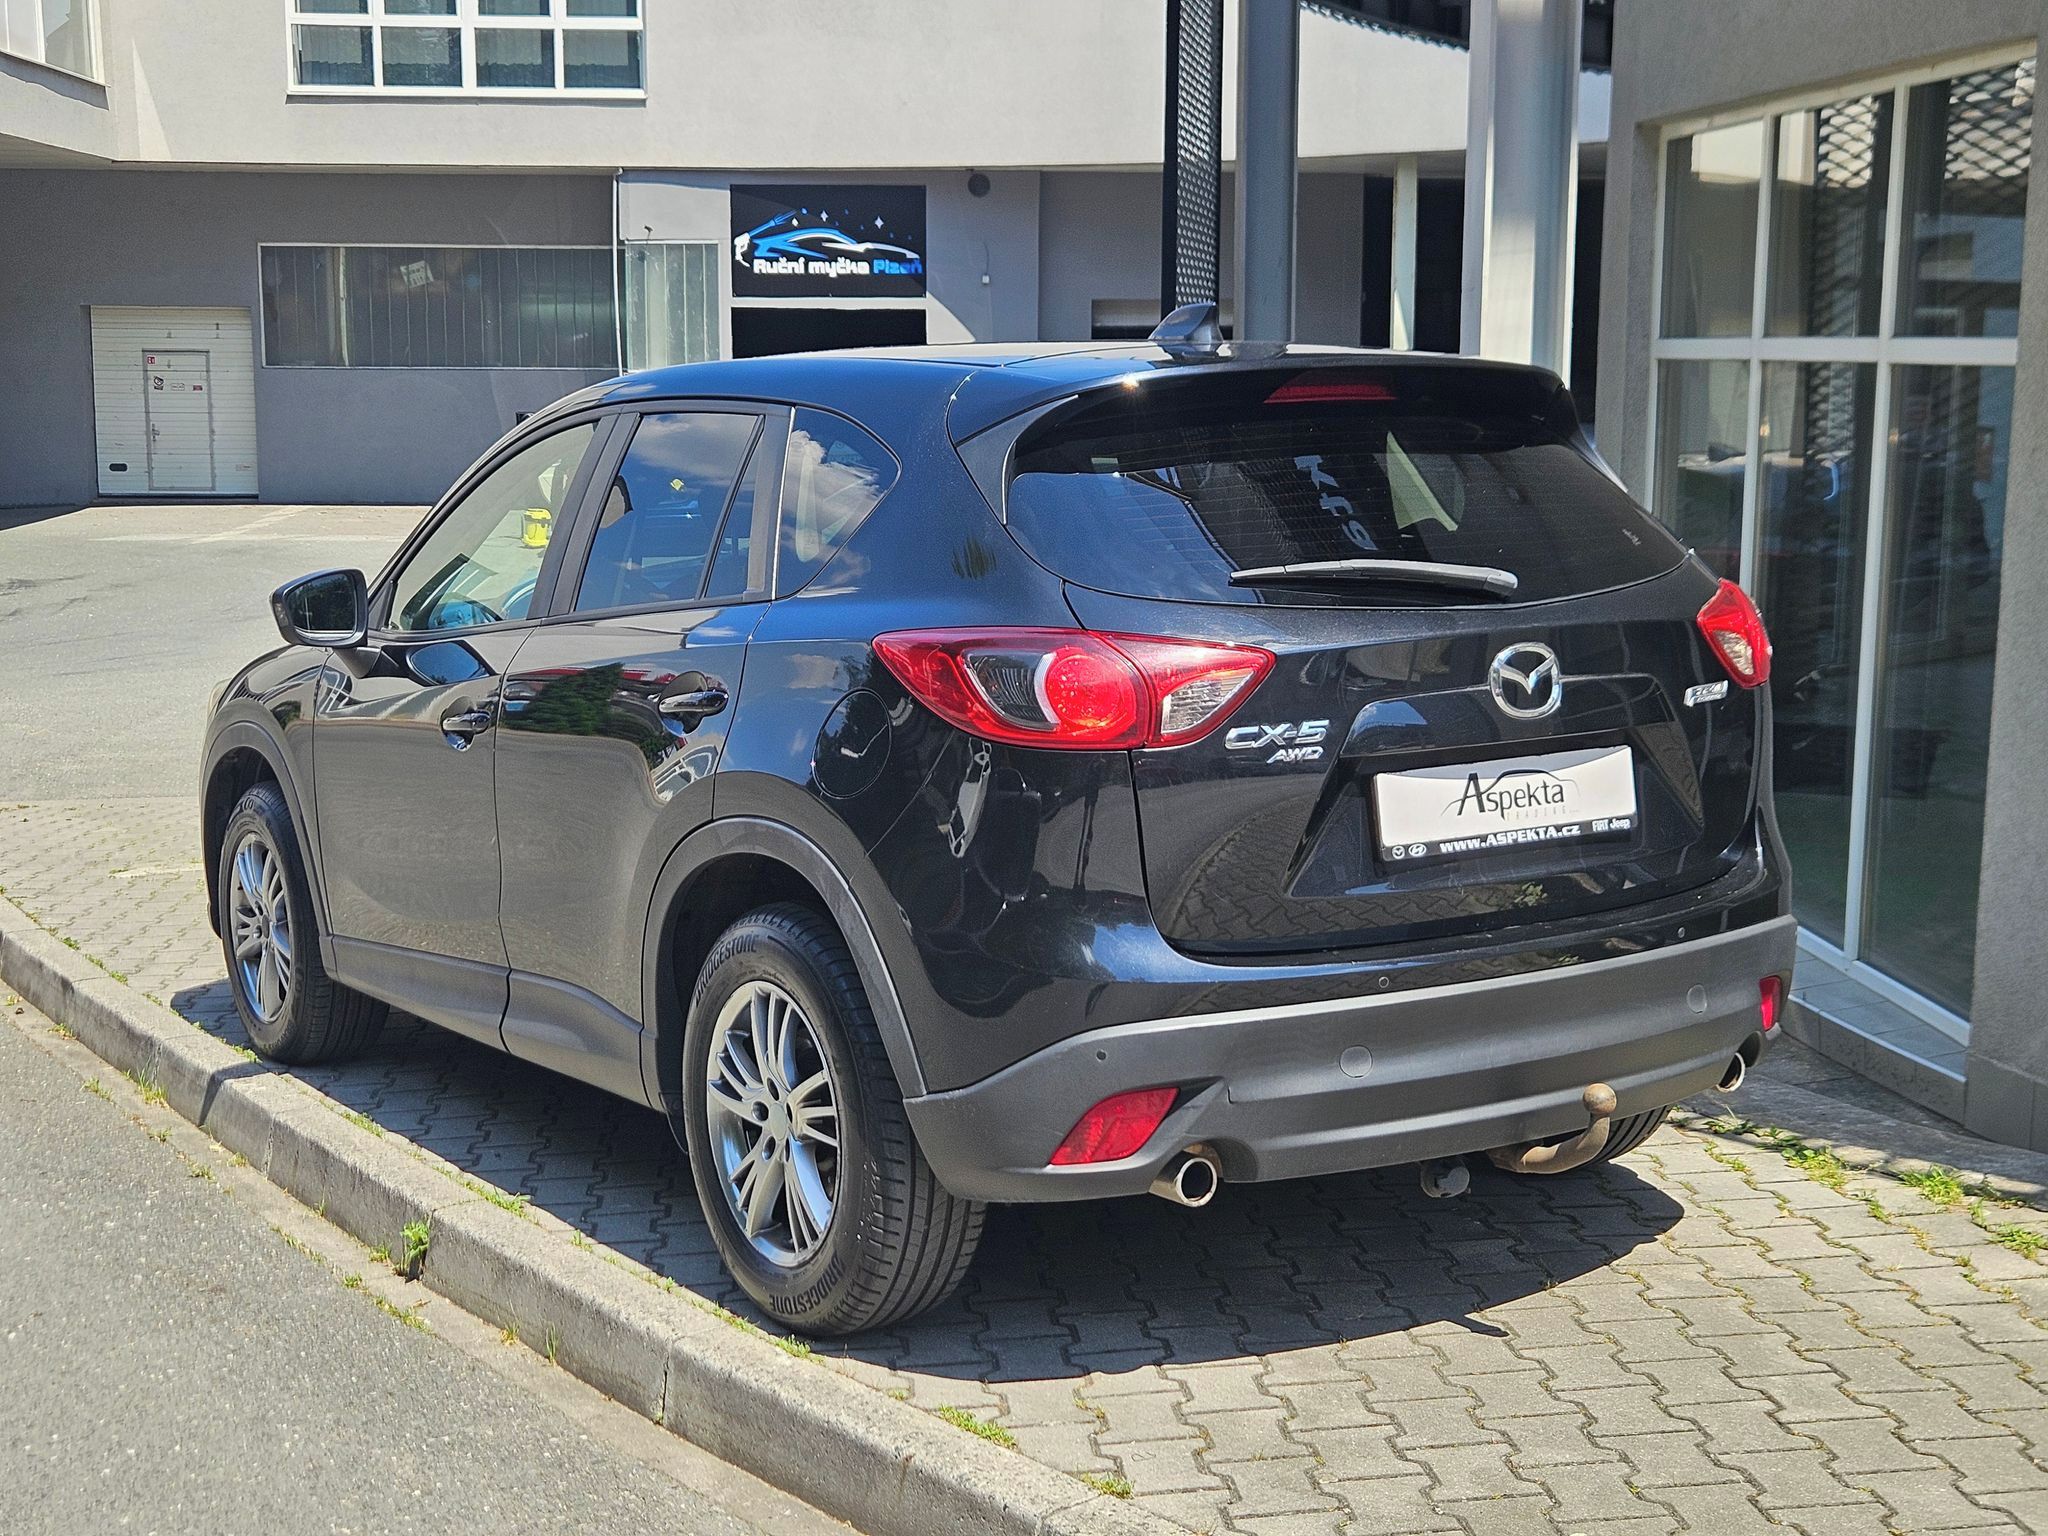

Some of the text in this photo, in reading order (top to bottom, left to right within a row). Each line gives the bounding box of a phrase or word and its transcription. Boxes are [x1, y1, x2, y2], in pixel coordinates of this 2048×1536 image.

[753, 257, 805, 274] Ruční
[808, 257, 870, 277] myčka
[1224, 719, 1330, 750] CX-5
[1266, 746, 1324, 764] AWD
[1457, 771, 1565, 820] Aspekta
[1592, 818, 1631, 832] FIAT Jeep
[696, 934, 759, 1008] BRIDGESTONE
[769, 1249, 845, 1315] BRIDGESTONE
